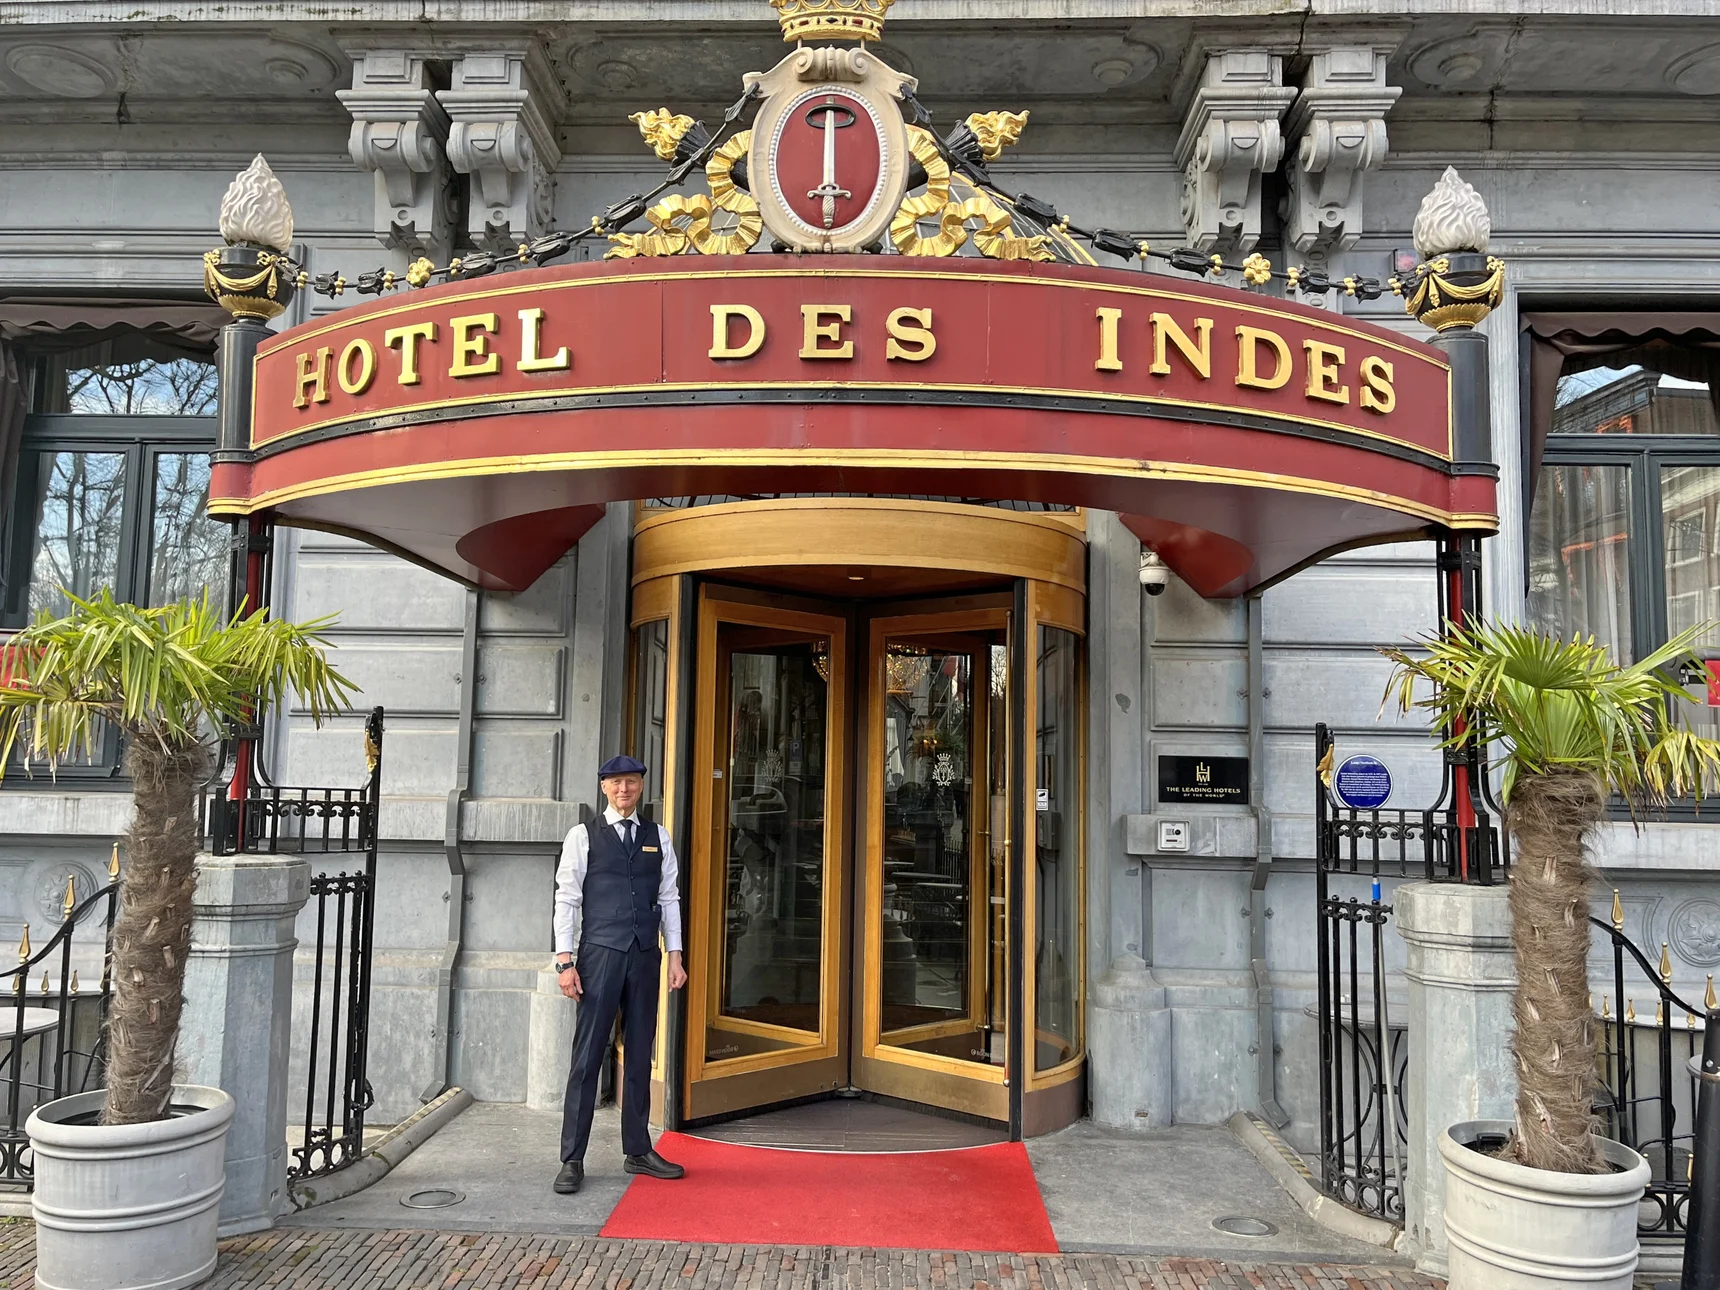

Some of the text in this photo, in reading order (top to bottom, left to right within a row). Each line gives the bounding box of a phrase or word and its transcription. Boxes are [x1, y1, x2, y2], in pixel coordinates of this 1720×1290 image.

[293, 304, 1397, 414] HOTEL DES INDES
